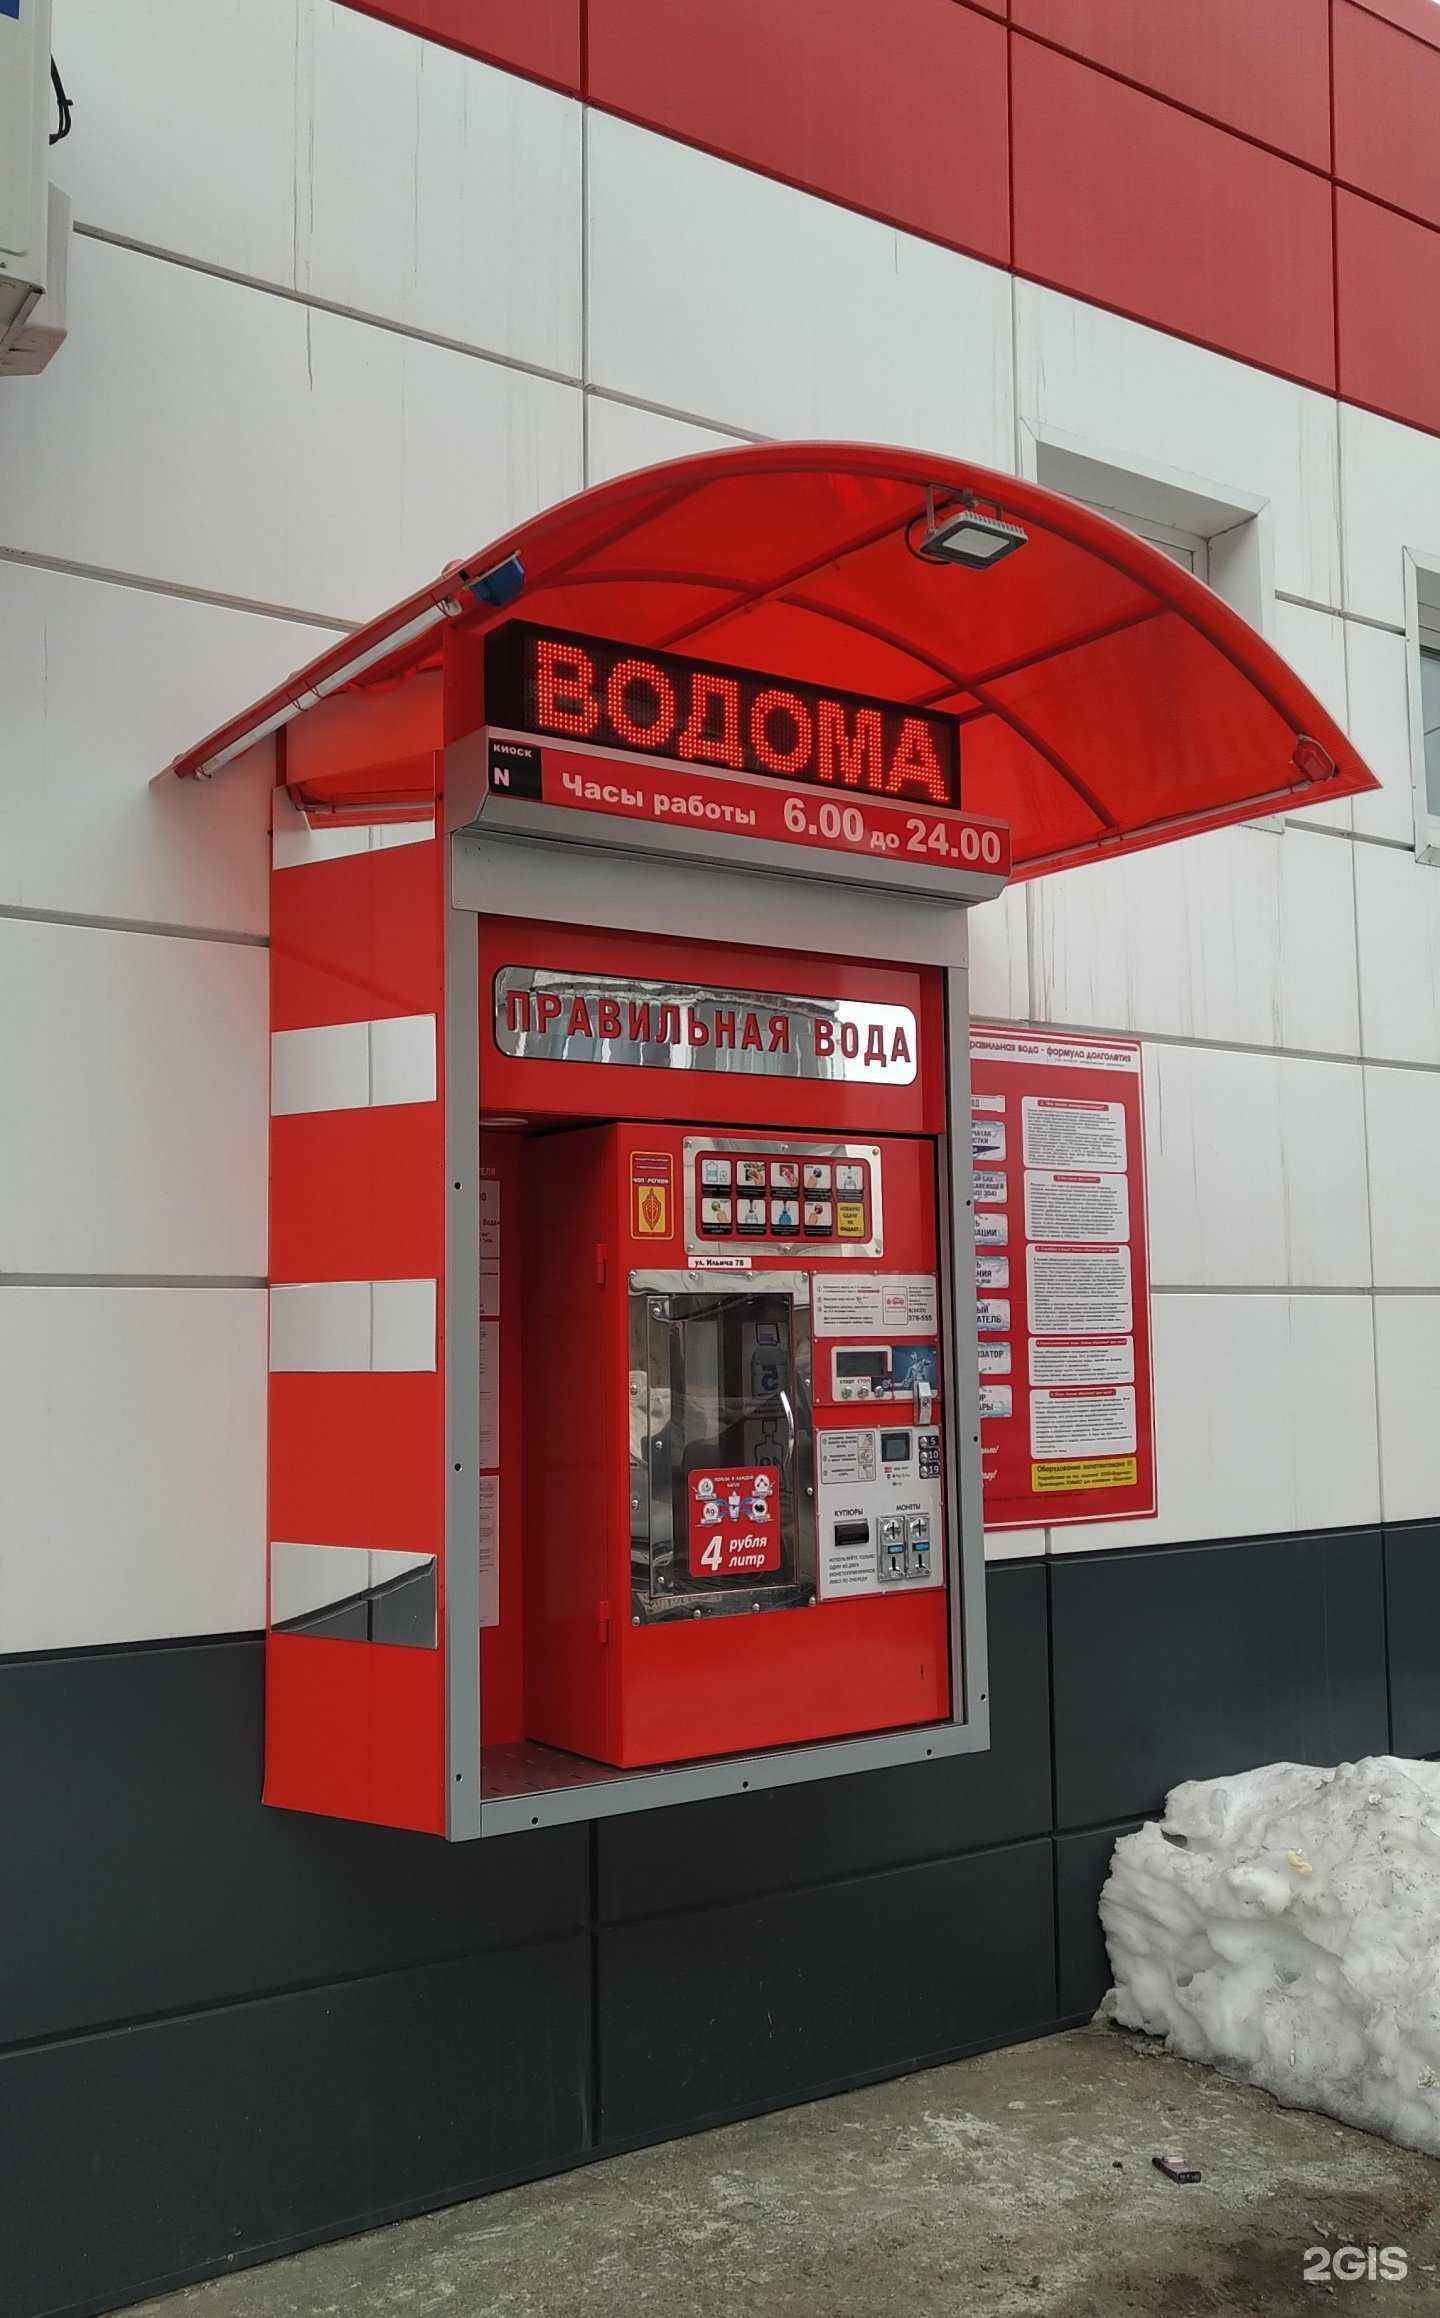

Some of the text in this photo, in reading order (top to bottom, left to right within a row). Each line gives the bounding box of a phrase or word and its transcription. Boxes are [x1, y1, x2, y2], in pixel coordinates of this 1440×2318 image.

[536, 639, 950, 801] ВОДОМА
[493, 743, 532, 758] КИОСК
[494, 767, 510, 787] N
[562, 773, 1001, 864] Часы работы 6.00 до 24.00
[506, 990, 911, 1068] ПРАВИЛЬНАЯ ВОДА
[969, 1040, 1016, 1052] равильная
[1047, 1047, 1085, 1060] формула
[695, 1260, 704, 1268] ул.
[929, 1450, 939, 1459] 10
[929, 1465, 939, 1474] 19
[834, 1508, 863, 1517] КУПЮРЫ
[896, 1503, 921, 1512] МОНЕТЫ
[701, 1534, 768, 1571] 4 рубля
[728, 1554, 765, 1568] литр
